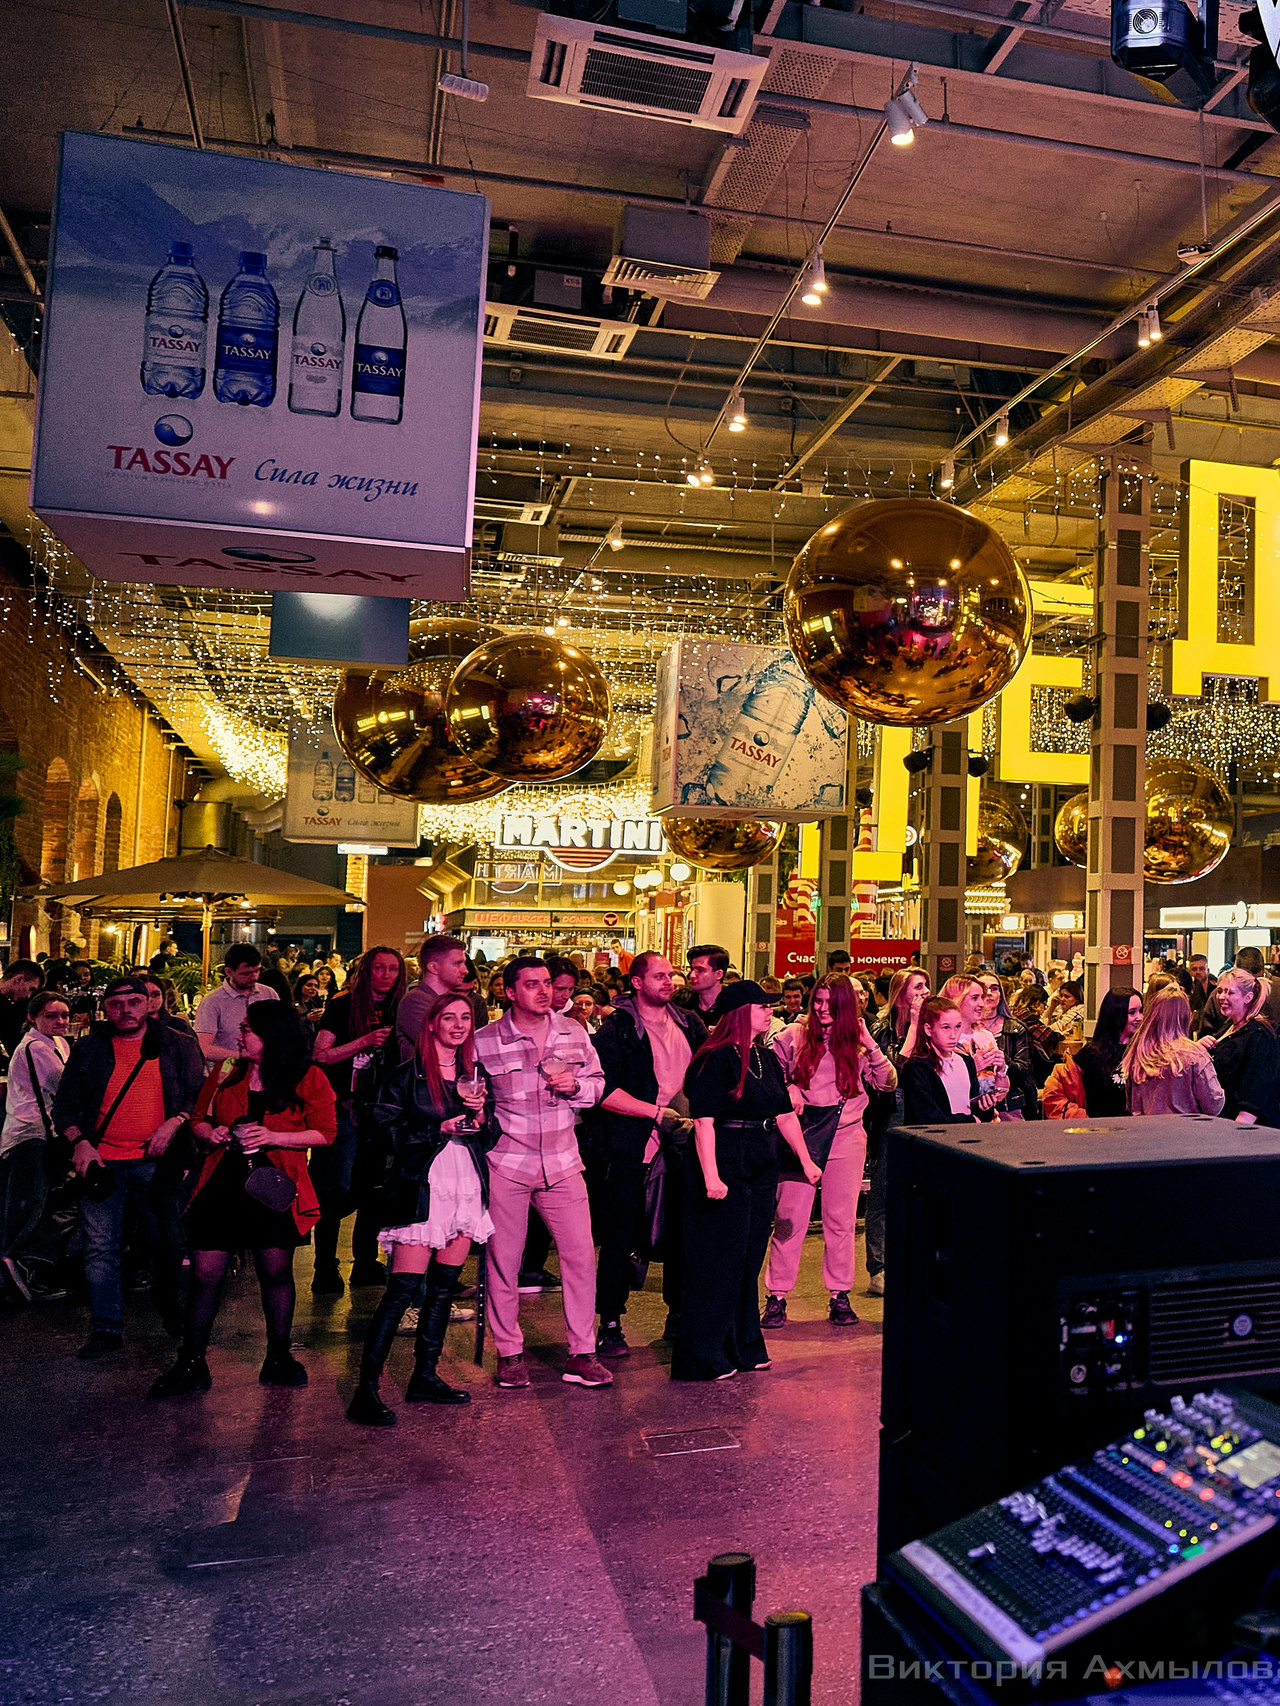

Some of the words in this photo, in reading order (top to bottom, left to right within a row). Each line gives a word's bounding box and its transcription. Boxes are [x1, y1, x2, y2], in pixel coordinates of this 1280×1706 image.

[150, 336, 202, 352] TASSAY
[223, 344, 272, 360] TASSAY
[293, 354, 342, 370] TASSAY
[356, 362, 403, 378] TASSAY
[106, 445, 237, 480] TASSAY
[254, 458, 320, 486] Сила
[327, 472, 420, 502] жизни
[117, 552, 422, 584] TASSAY
[731, 736, 782, 768] TASSAY
[303, 816, 343, 826] TASSAY
[503, 814, 661, 850] MARTINI
[787, 951, 816, 964] Счас
[857, 956, 907, 965] моменте
